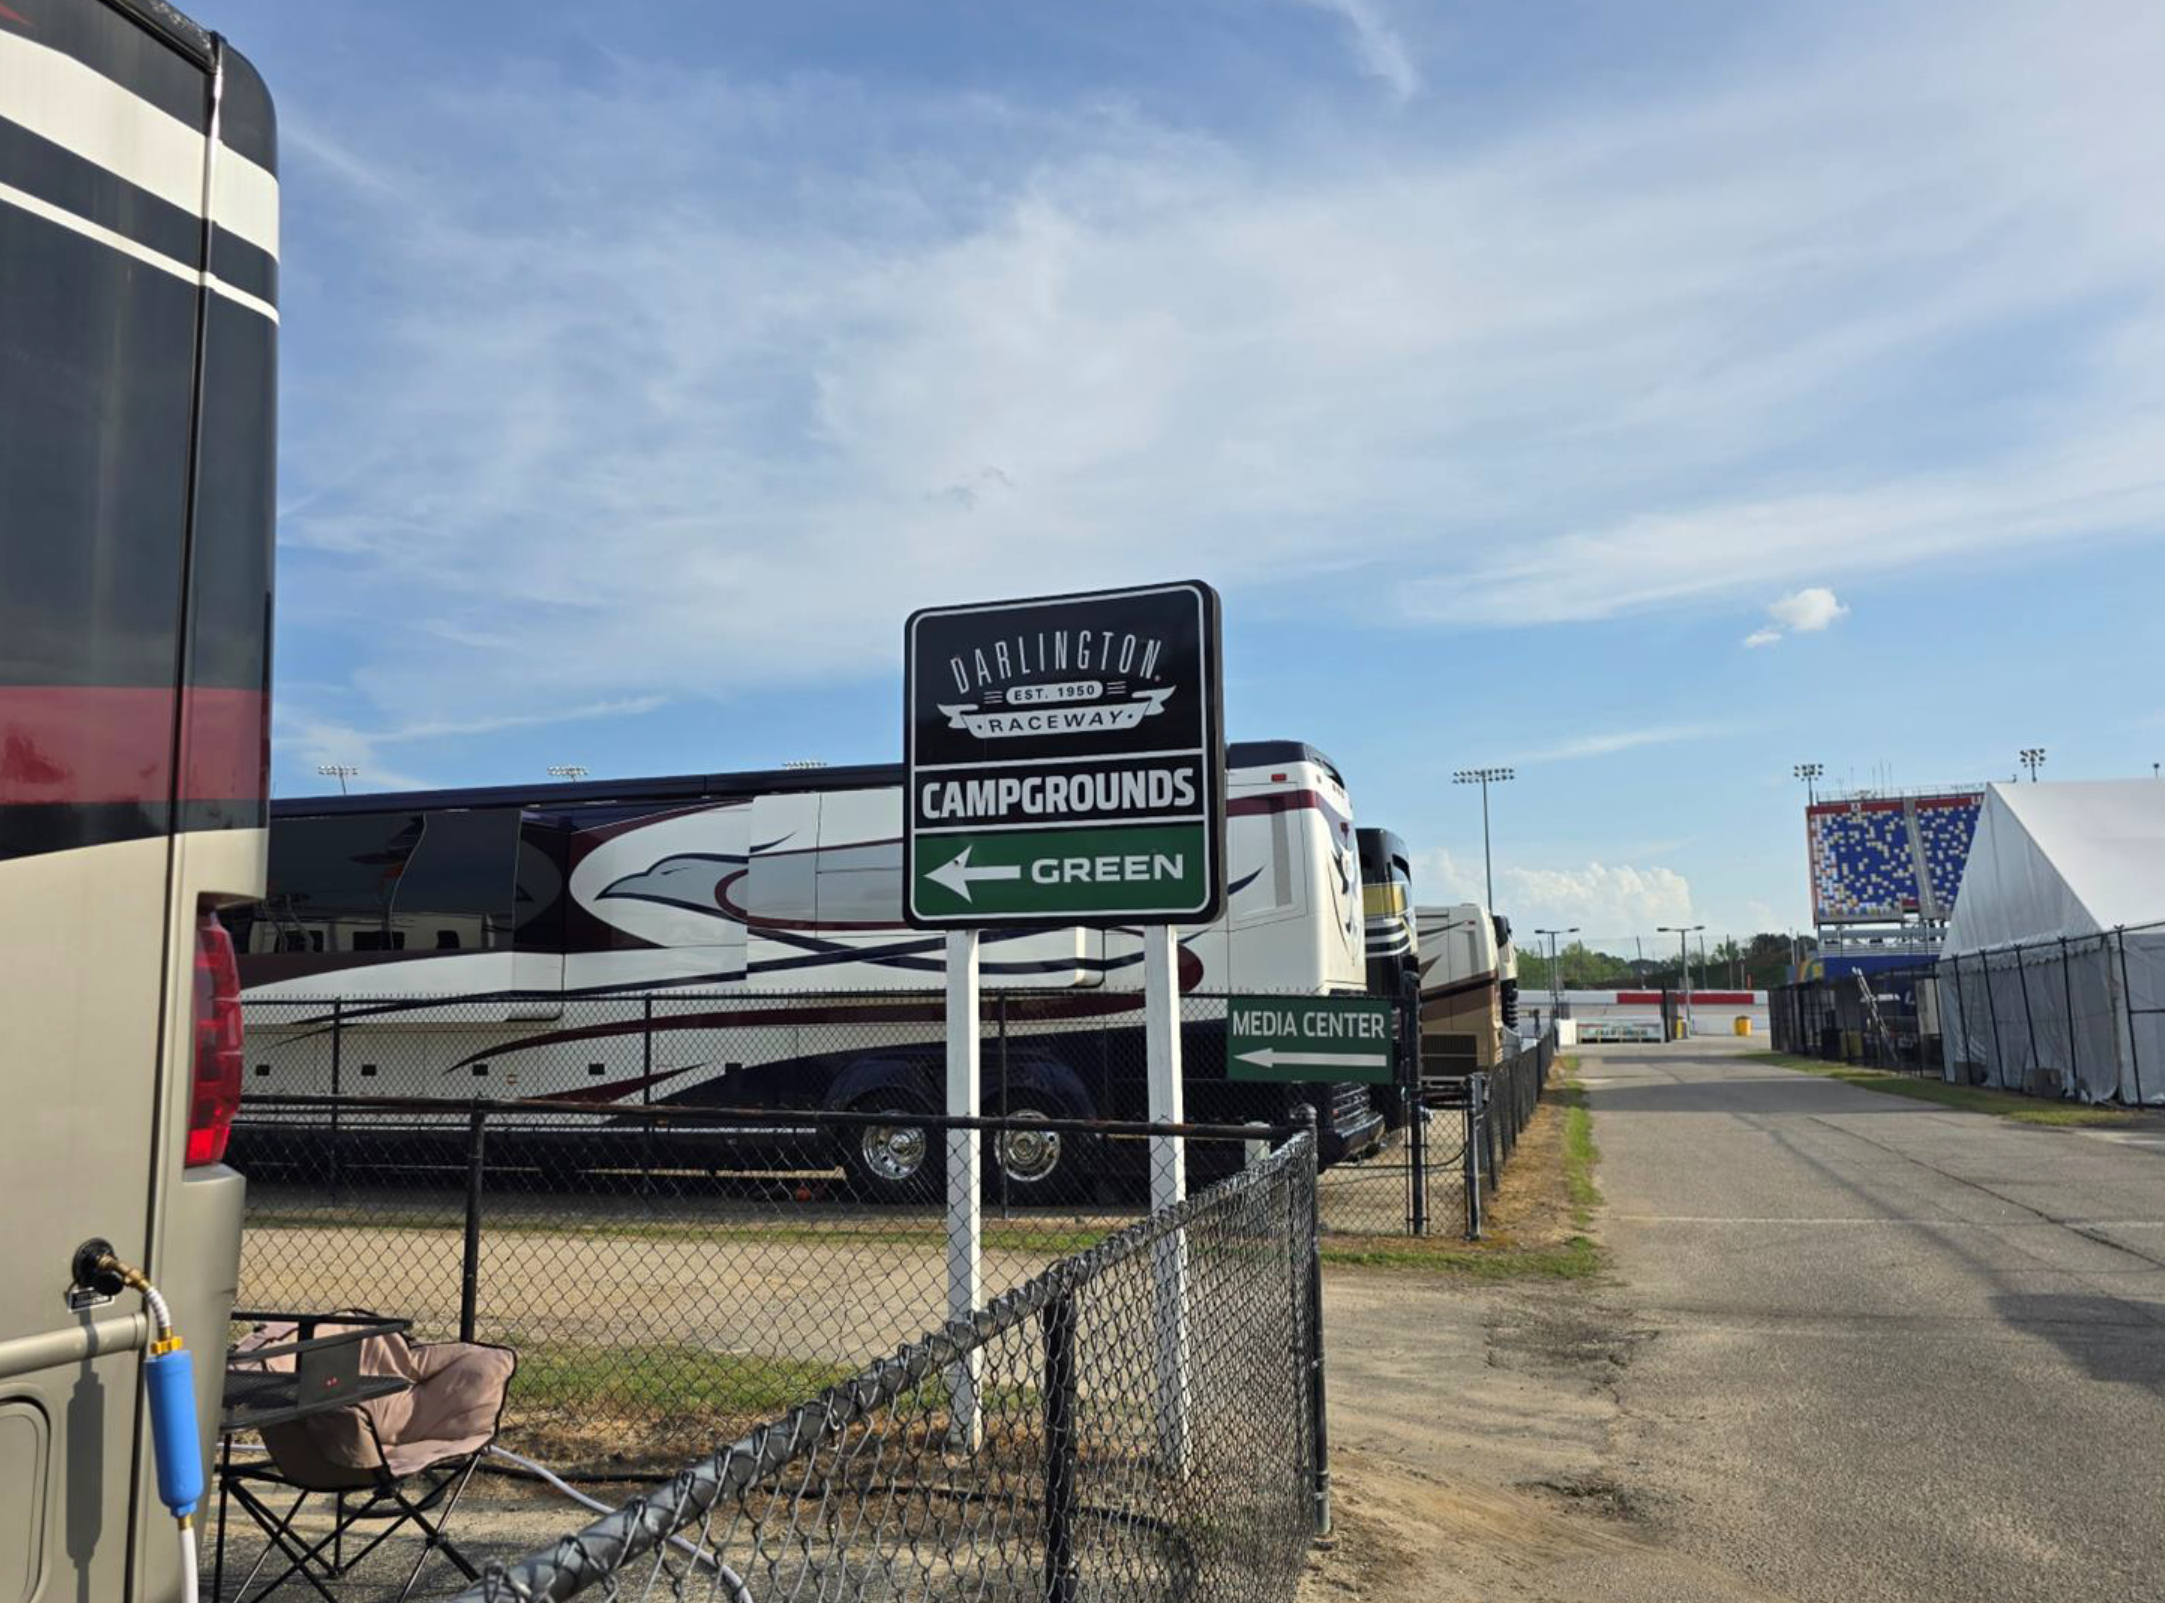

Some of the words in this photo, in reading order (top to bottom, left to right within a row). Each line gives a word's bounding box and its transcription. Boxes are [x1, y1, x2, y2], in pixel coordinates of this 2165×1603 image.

[951, 630, 1161, 694] DARLINGTON
[1014, 687, 1048, 700] EST.
[1057, 685, 1095, 697] 1950
[989, 710, 1123, 733] RACEWAY
[922, 768, 1195, 819] CAMPGROUNDS
[1031, 854, 1183, 884] GREEN
[1232, 1010, 1298, 1037] MEDIA
[1303, 1011, 1385, 1039] CENTER
